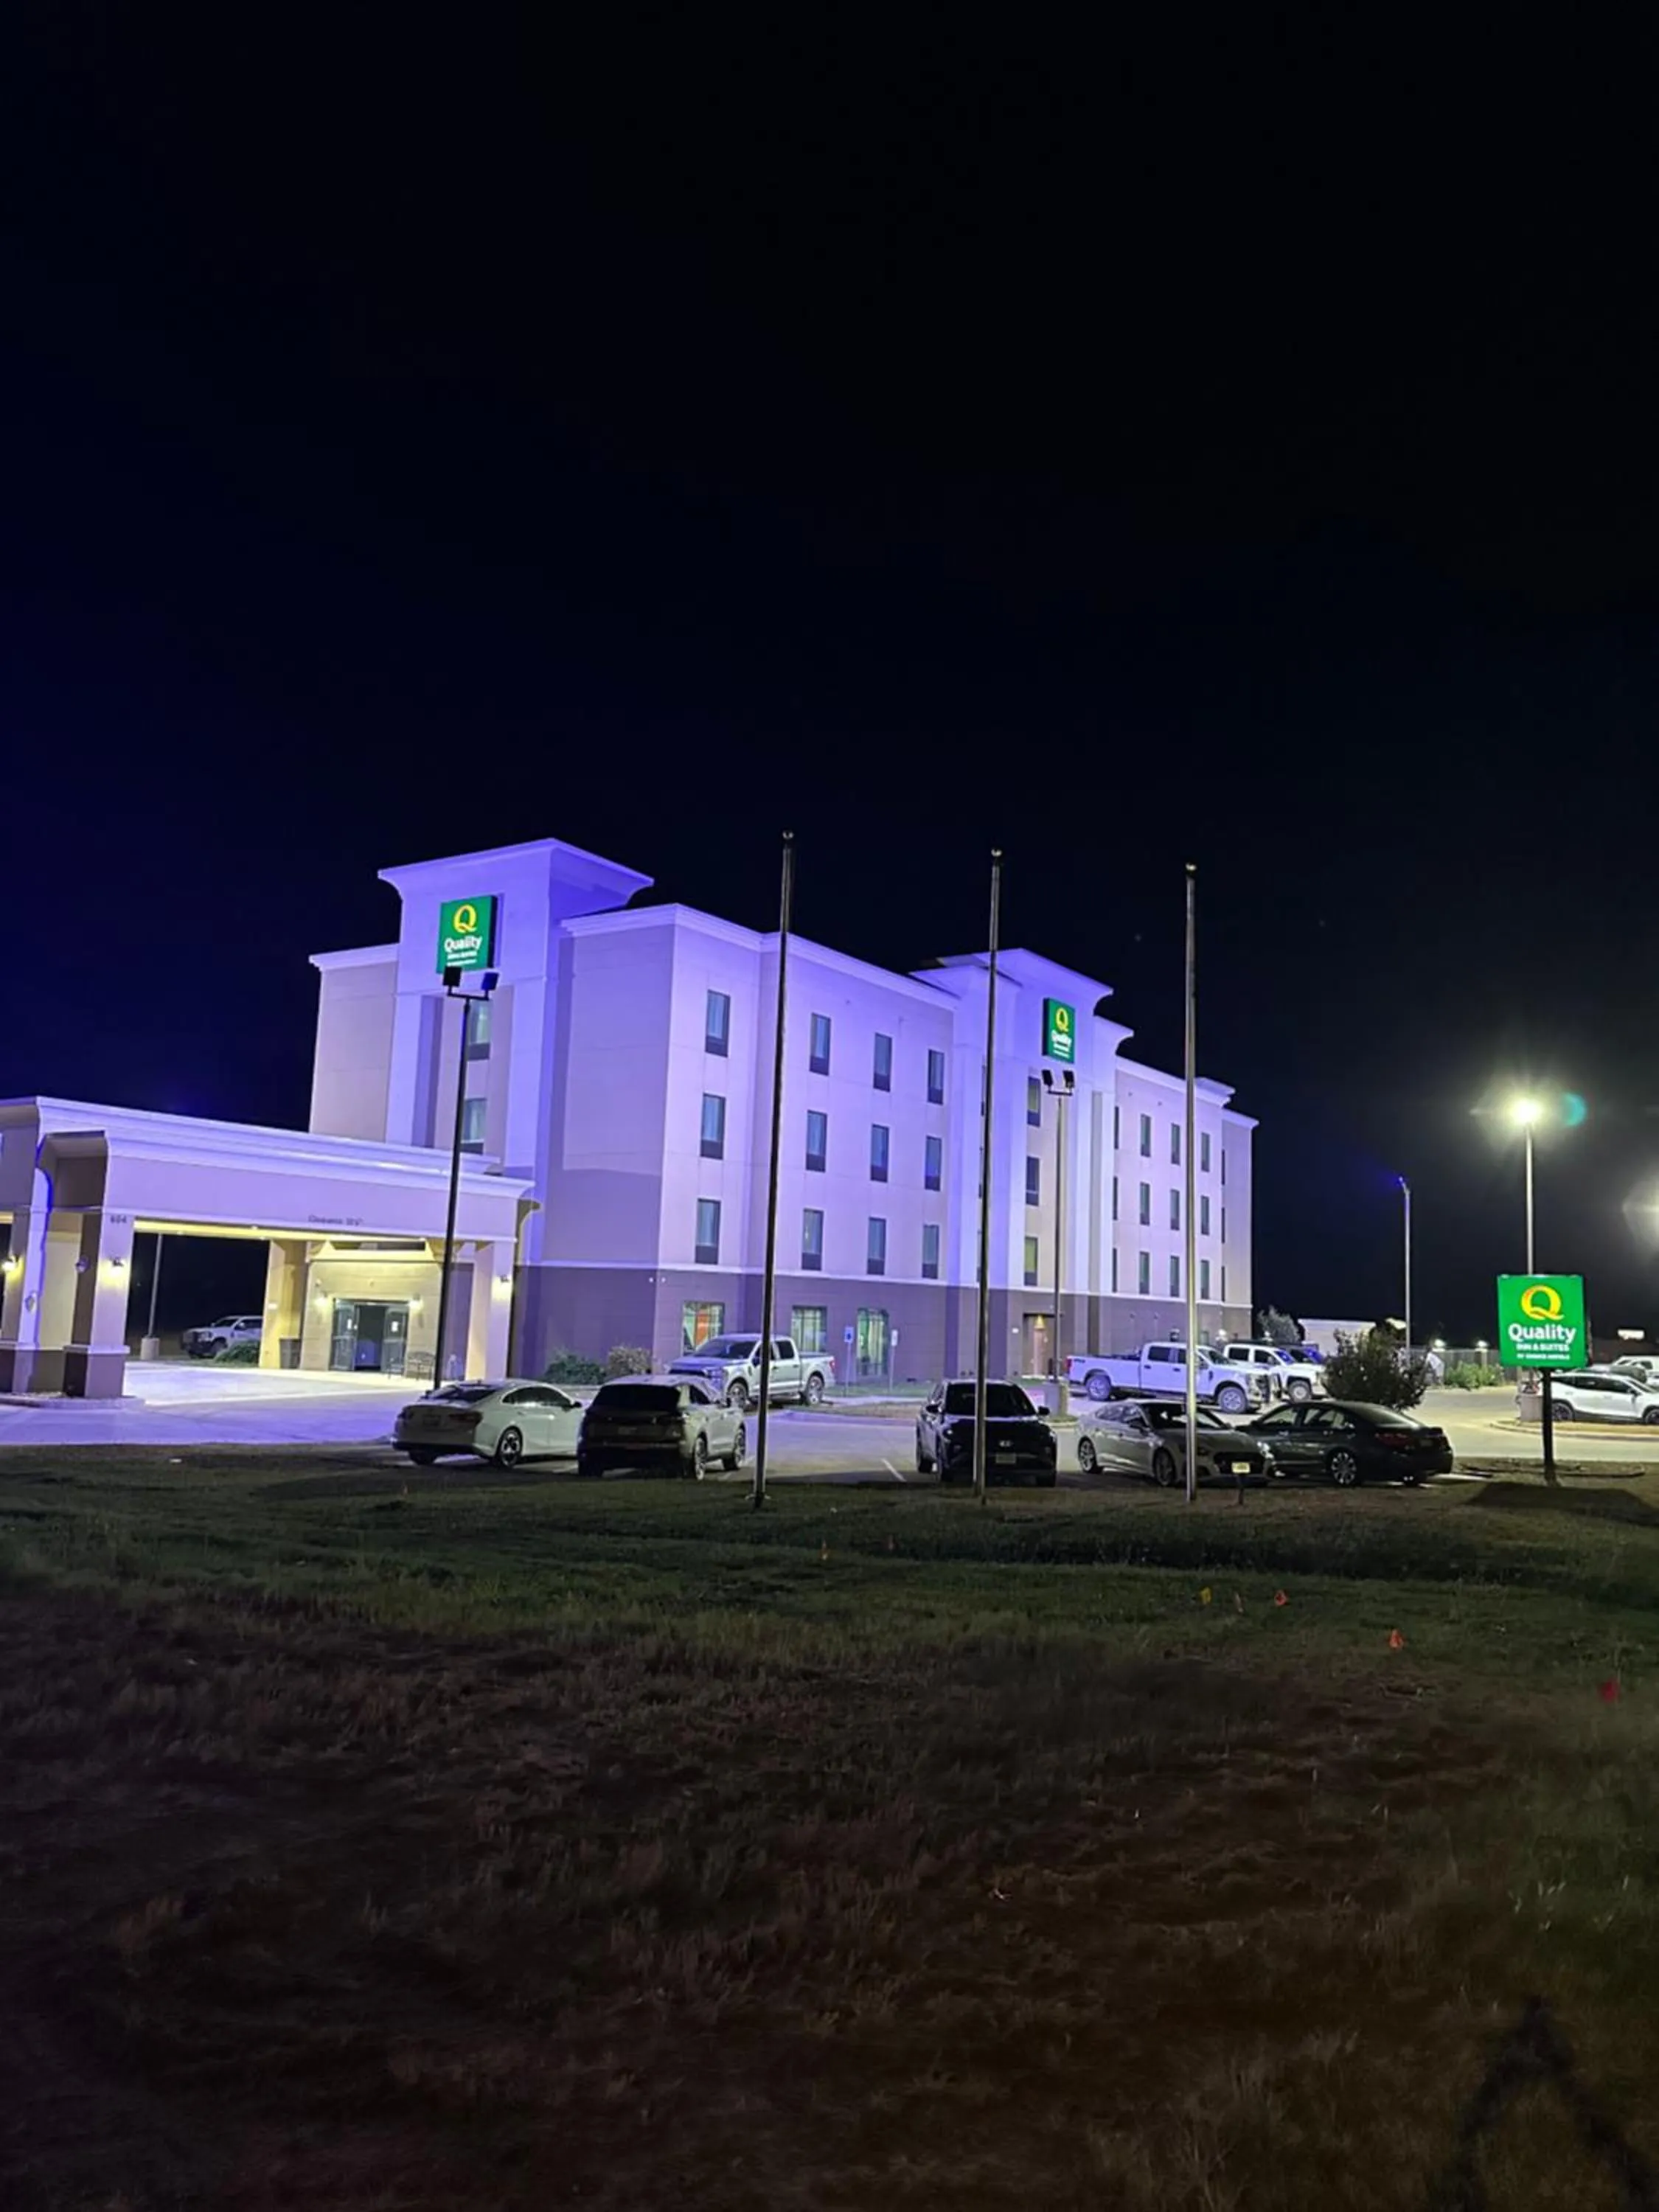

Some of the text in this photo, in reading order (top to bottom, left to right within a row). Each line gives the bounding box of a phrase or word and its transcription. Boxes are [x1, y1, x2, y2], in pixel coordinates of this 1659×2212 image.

[454, 904, 477, 933] Q
[444, 935, 483, 953] Quality
[1056, 1007, 1069, 1032] Q
[1521, 1285, 1565, 1321] Q
[1508, 1323, 1576, 1344] Quality
